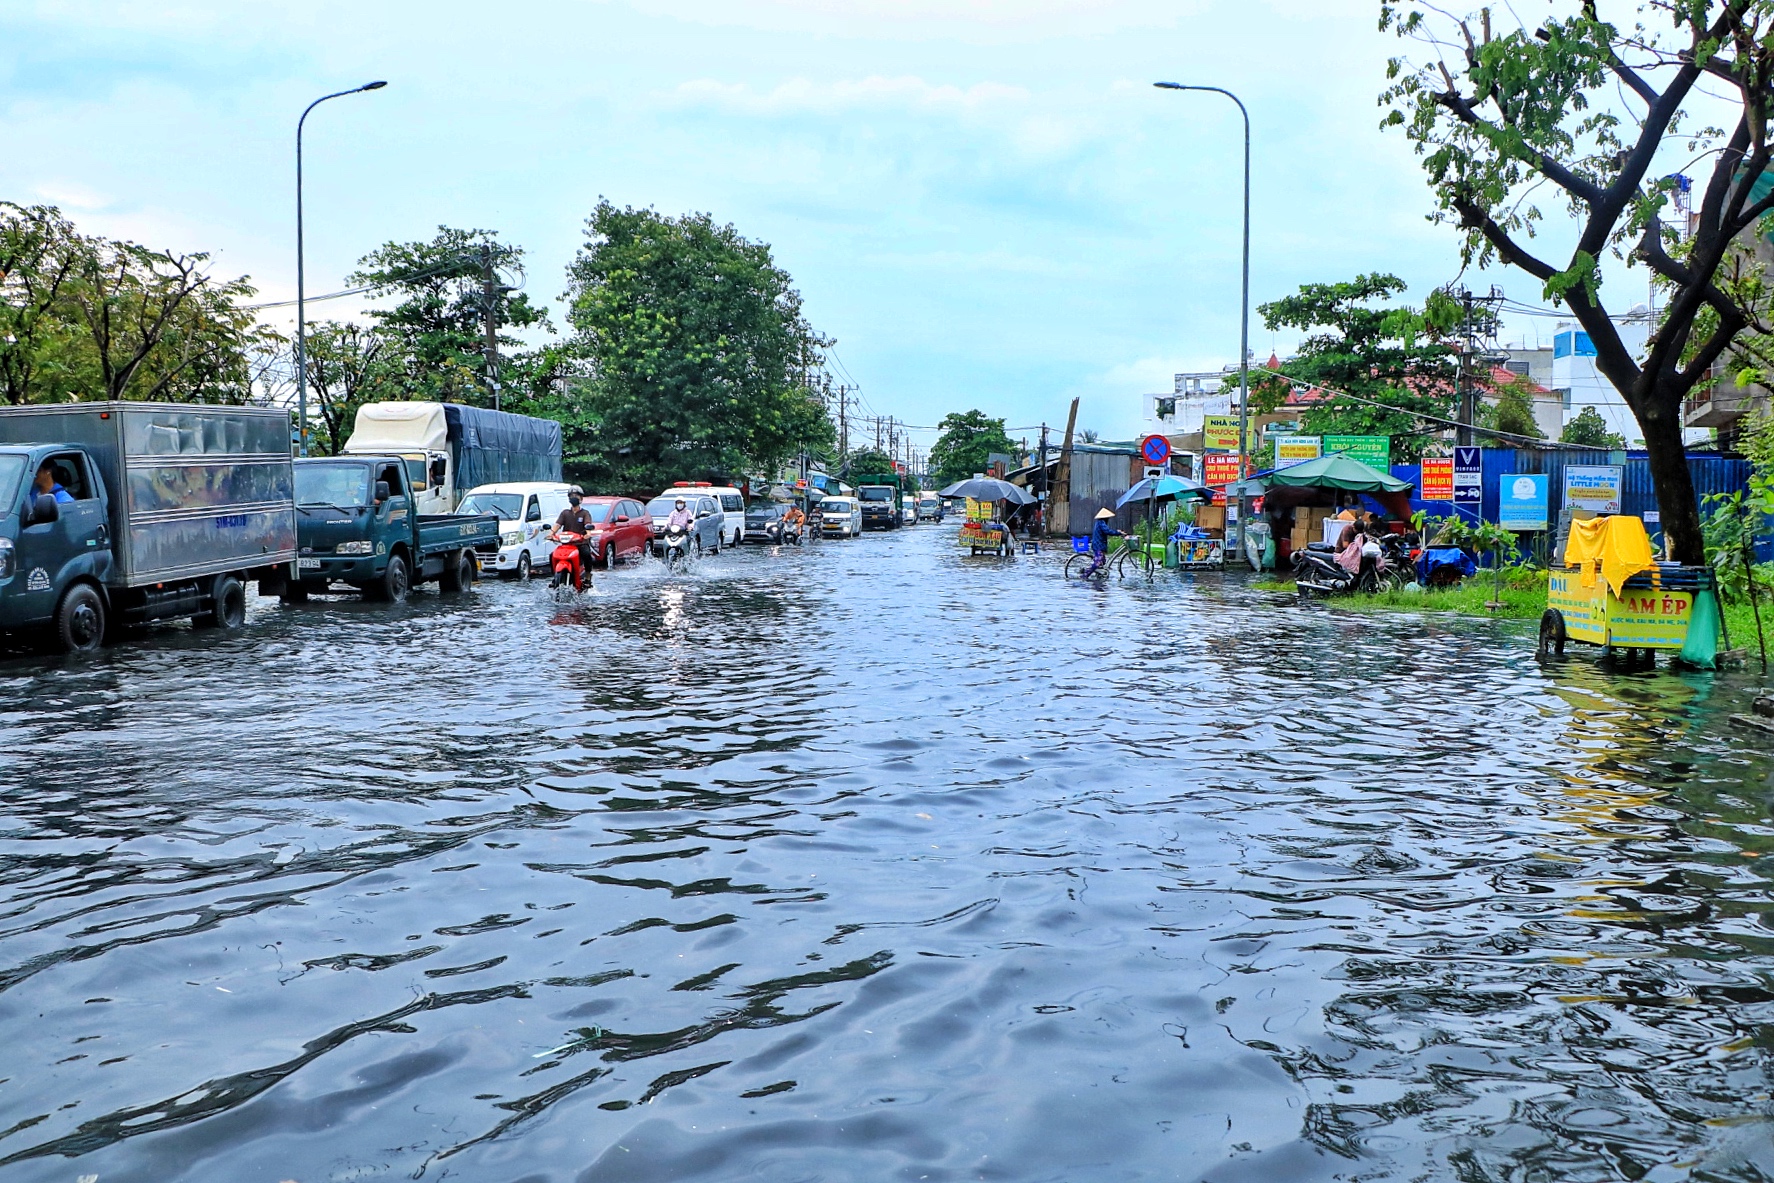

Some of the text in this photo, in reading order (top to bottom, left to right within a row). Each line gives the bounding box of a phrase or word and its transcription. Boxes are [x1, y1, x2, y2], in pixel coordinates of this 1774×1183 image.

[1227, 456, 1239, 464] HOU
[1618, 593, 1688, 615] AM ÉP
